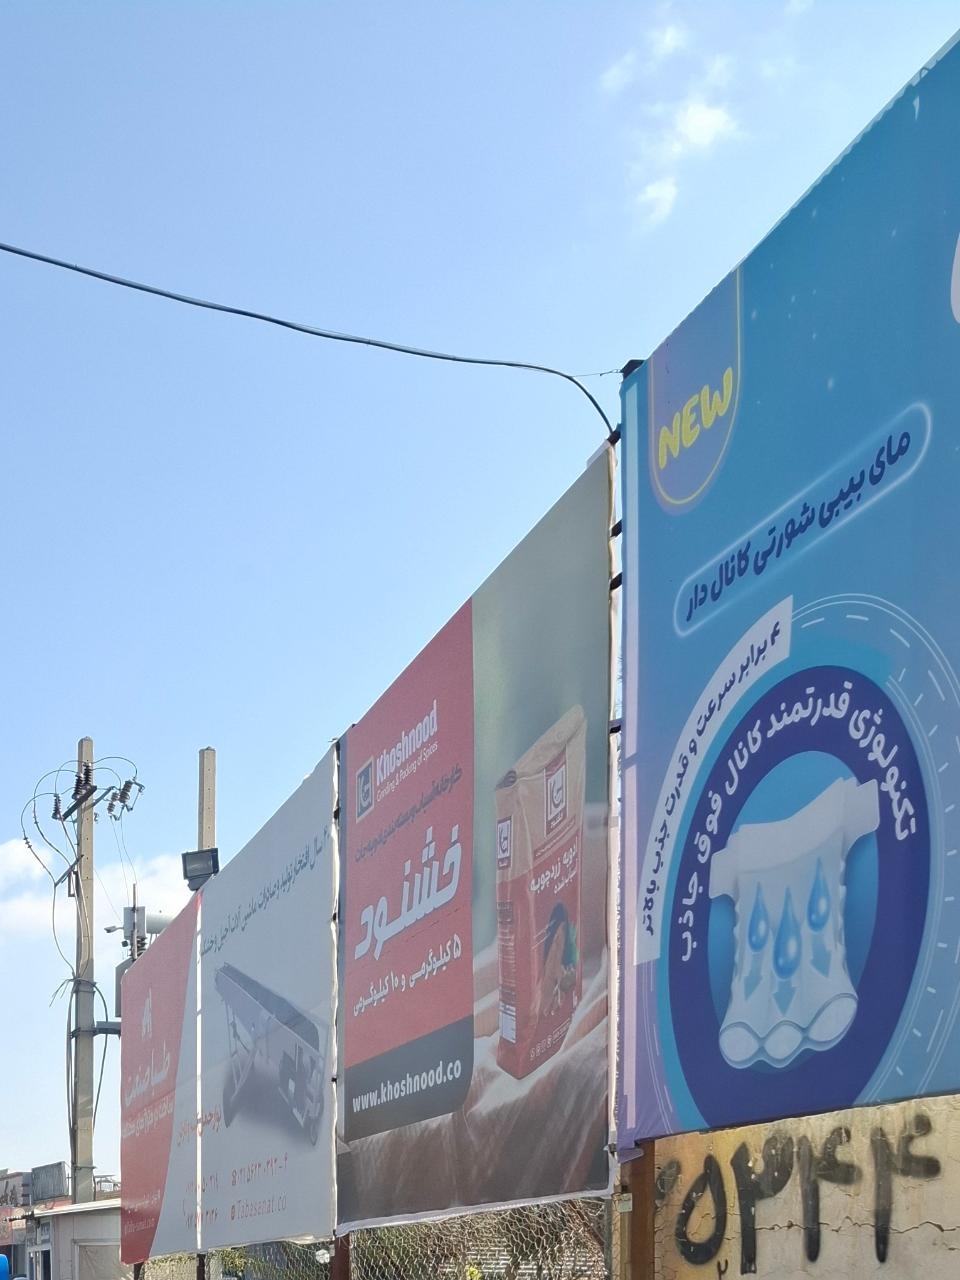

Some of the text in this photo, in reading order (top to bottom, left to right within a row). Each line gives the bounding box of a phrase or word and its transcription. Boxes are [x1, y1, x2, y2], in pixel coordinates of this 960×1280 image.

[658, 367, 732, 470] NEW
[686, 431, 911, 621] مای بیبی شورتی کانال دار
[738, 639, 768, 683] برابر
[376, 698, 438, 786] Khoshnood
[696, 672, 736, 737] سرعت
[665, 753, 689, 816] قدرت
[678, 680, 916, 962] تکنولوژی قدرتمند کانال فوق جاذب
[652, 819, 670, 874] جذب
[354, 824, 462, 961] خشنود
[353, 934, 461, 1017] ۵ کیلوگرمی و ۱۰ کیلوگرمی
[352, 1059, 462, 1113] www.khoshnood.co
